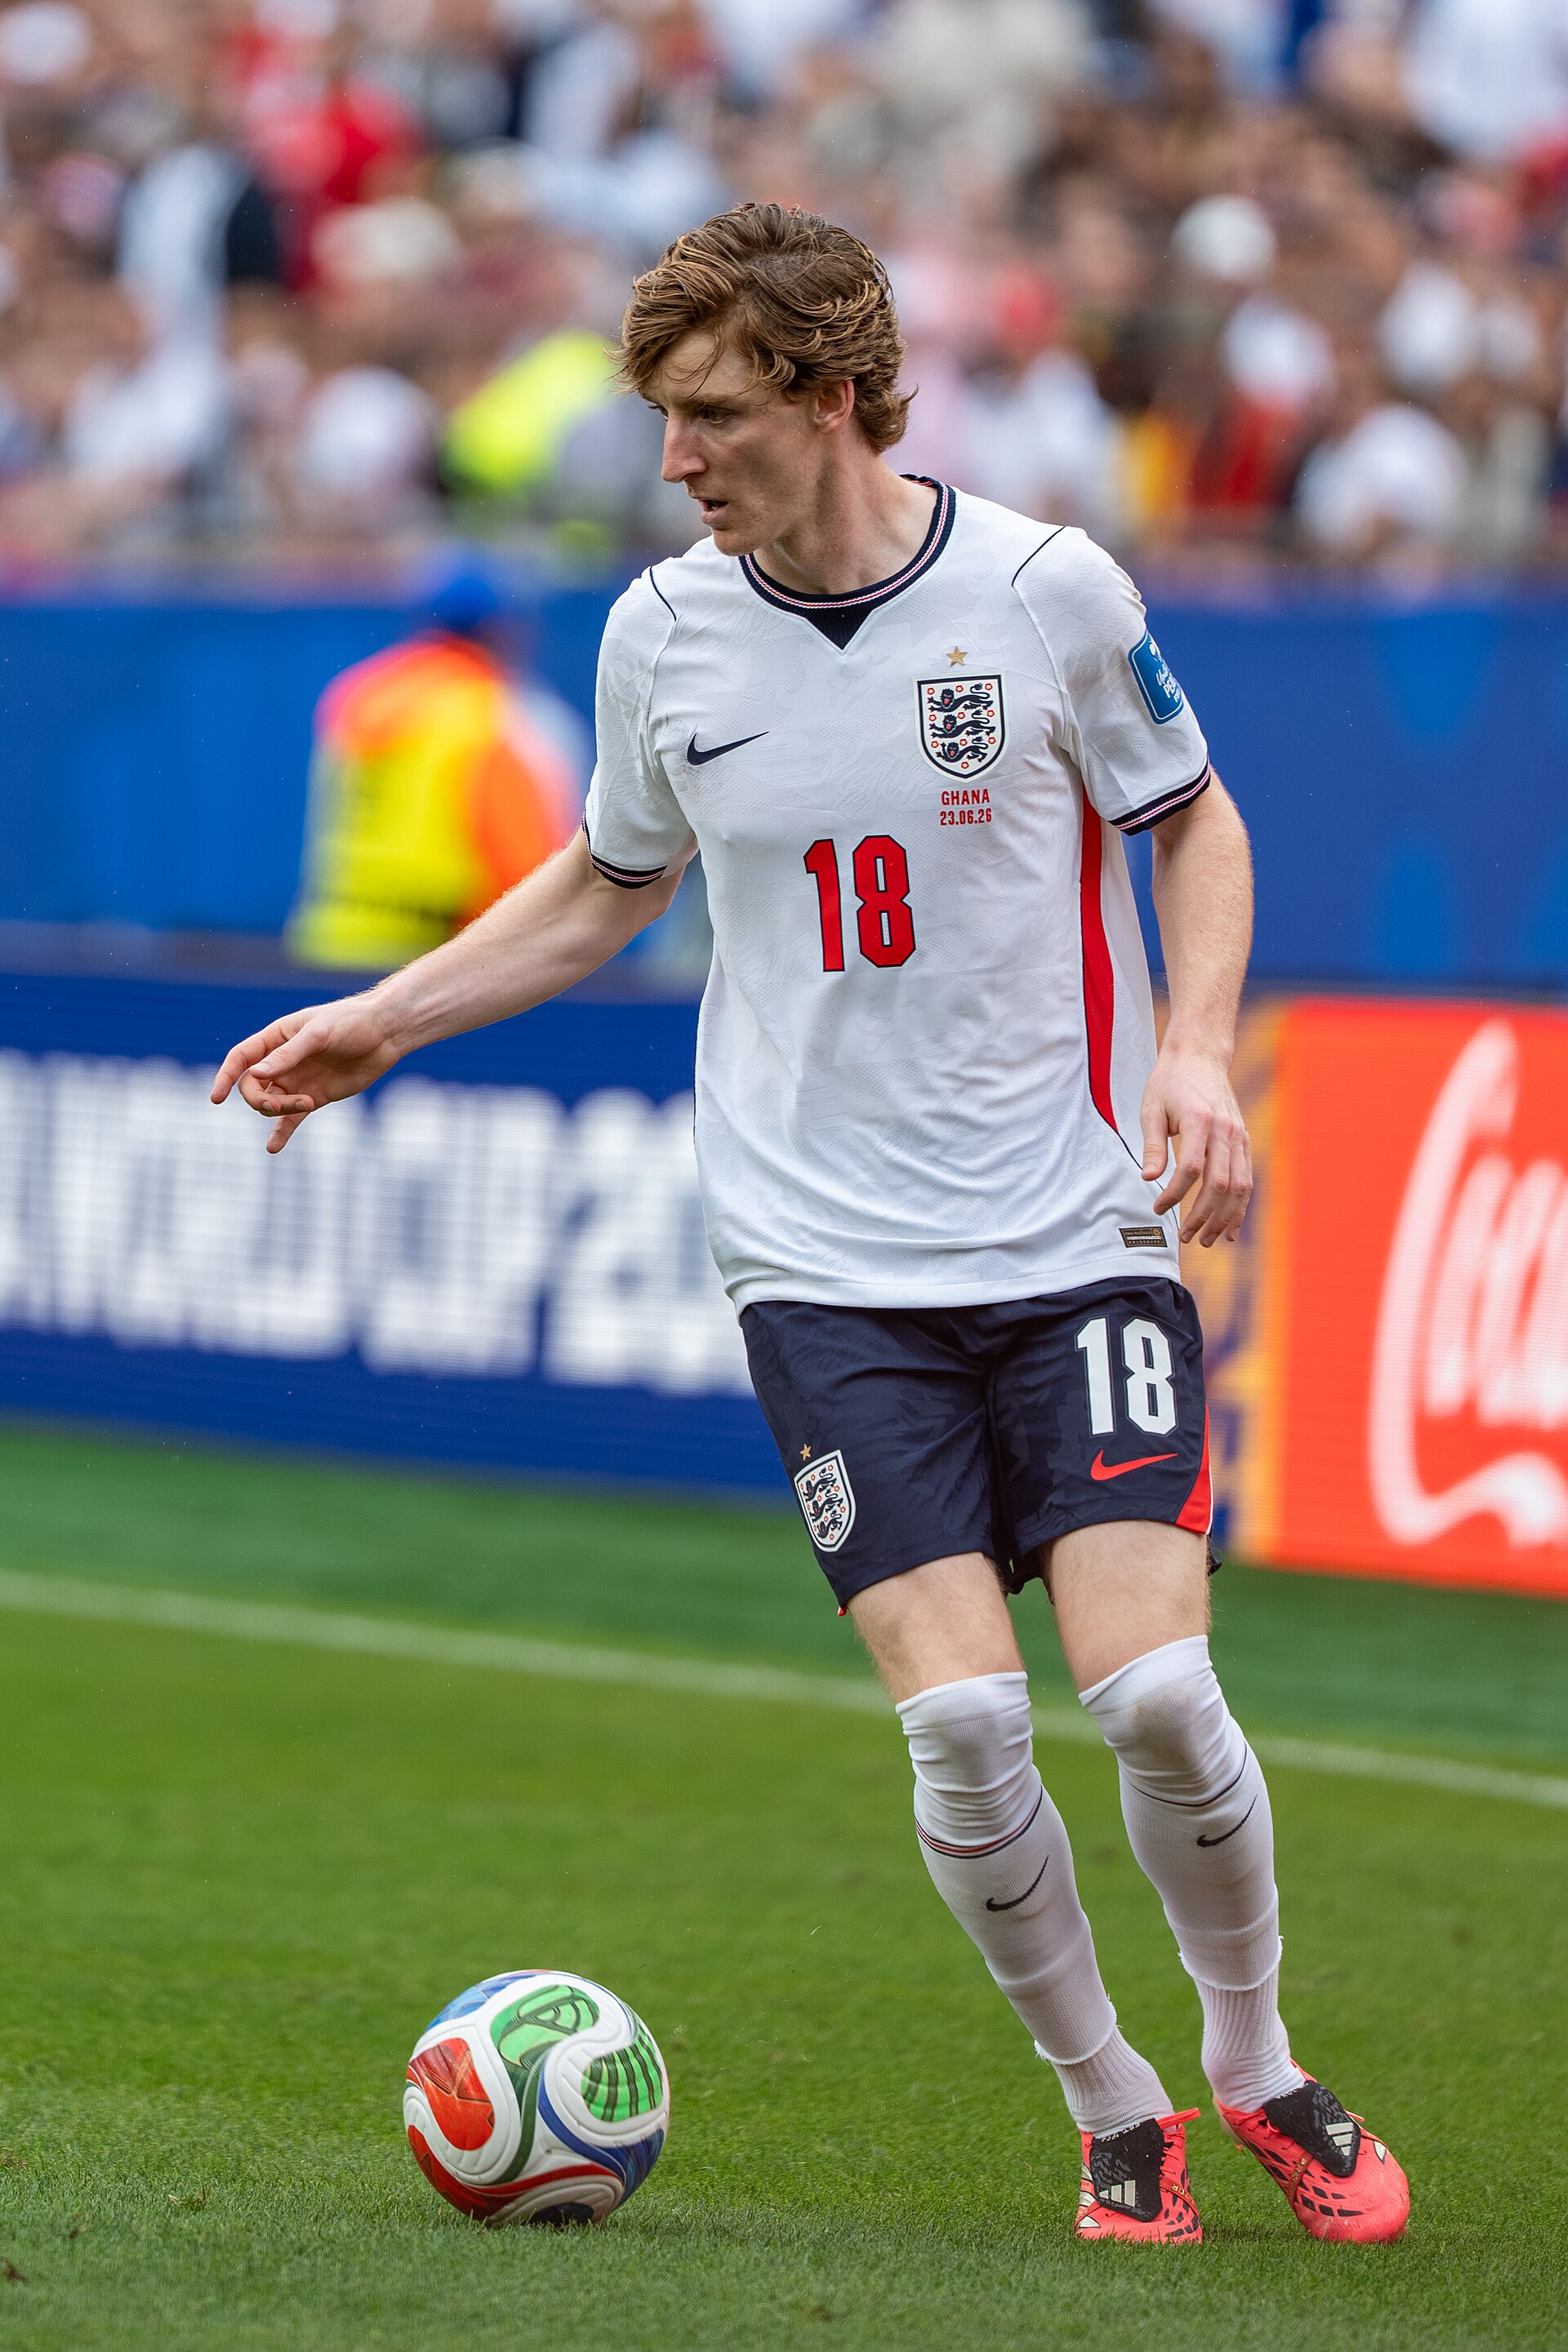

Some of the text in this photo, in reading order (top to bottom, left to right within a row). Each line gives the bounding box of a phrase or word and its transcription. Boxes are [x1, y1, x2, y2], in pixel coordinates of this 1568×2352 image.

[940, 807, 992, 826] 23.06.26
[941, 788, 991, 806] GHANA
[803, 834, 916, 973] 18
[1075, 1316, 1178, 1437] 18
